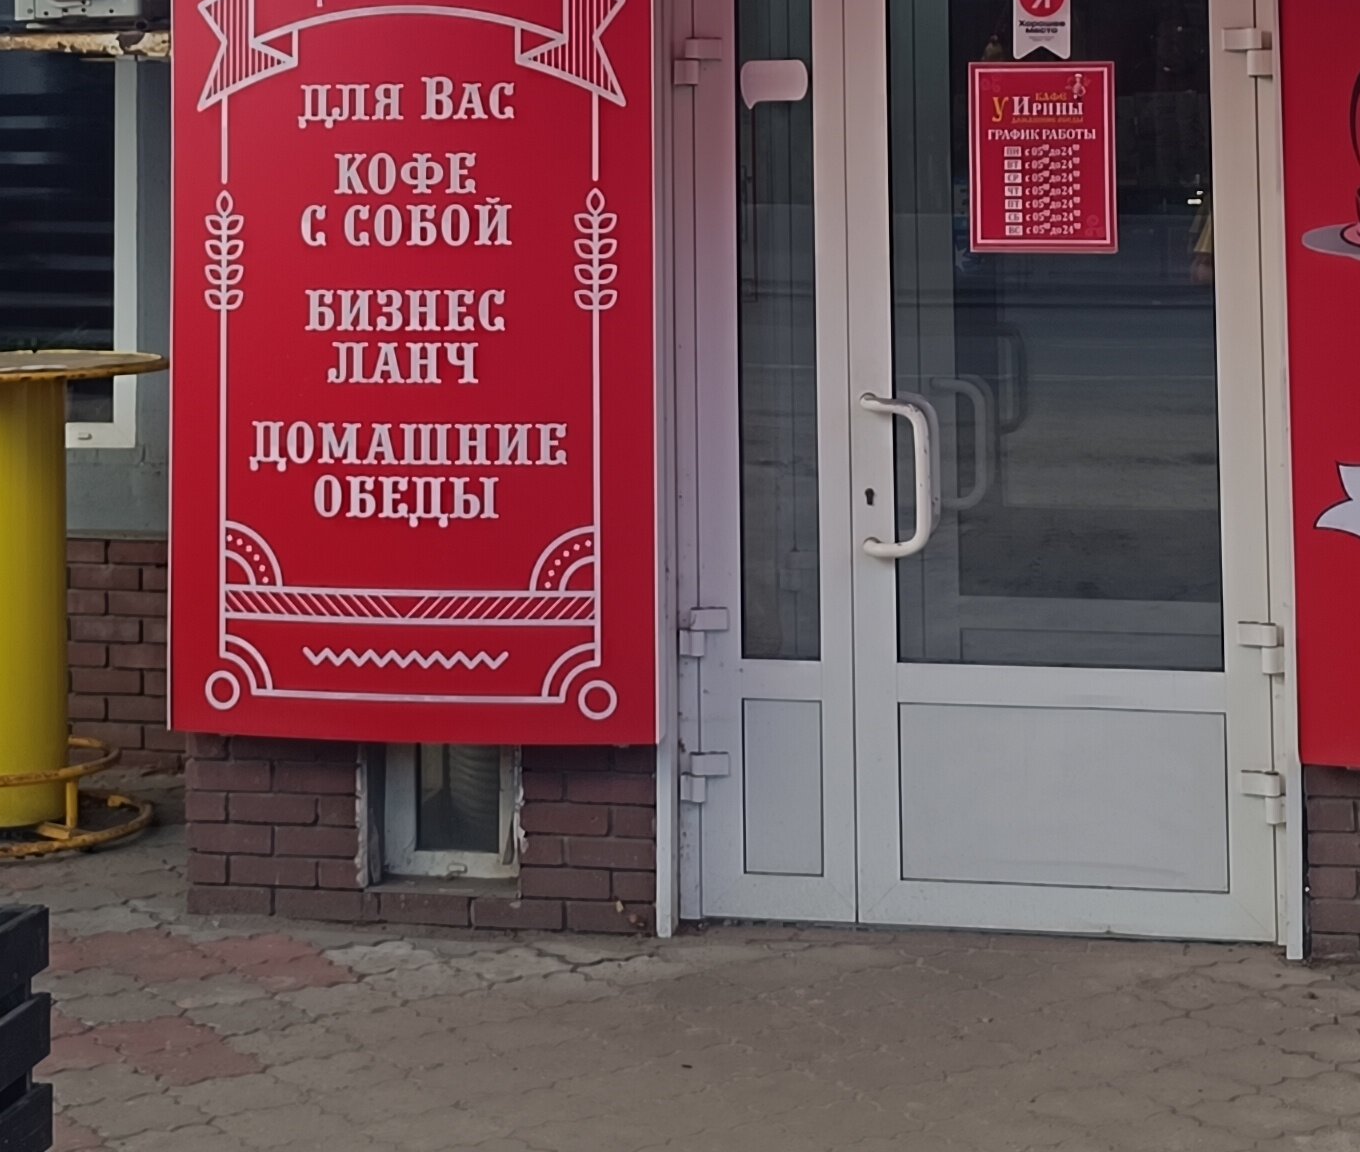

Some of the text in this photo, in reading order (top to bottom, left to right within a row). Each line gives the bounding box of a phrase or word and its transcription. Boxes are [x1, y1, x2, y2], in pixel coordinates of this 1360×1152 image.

[987, 128, 1096, 140] ГРАФИК РАБОТЫ
[334, 152, 476, 195] КОФЕ
[300, 197, 512, 247] С СОБОЙ
[305, 288, 506, 332] БИЗНЕС
[327, 341, 479, 384] ЛАНЧ
[249, 420, 568, 472] ДОМАШНИЕ
[313, 474, 499, 528] ОБЕДЫ
